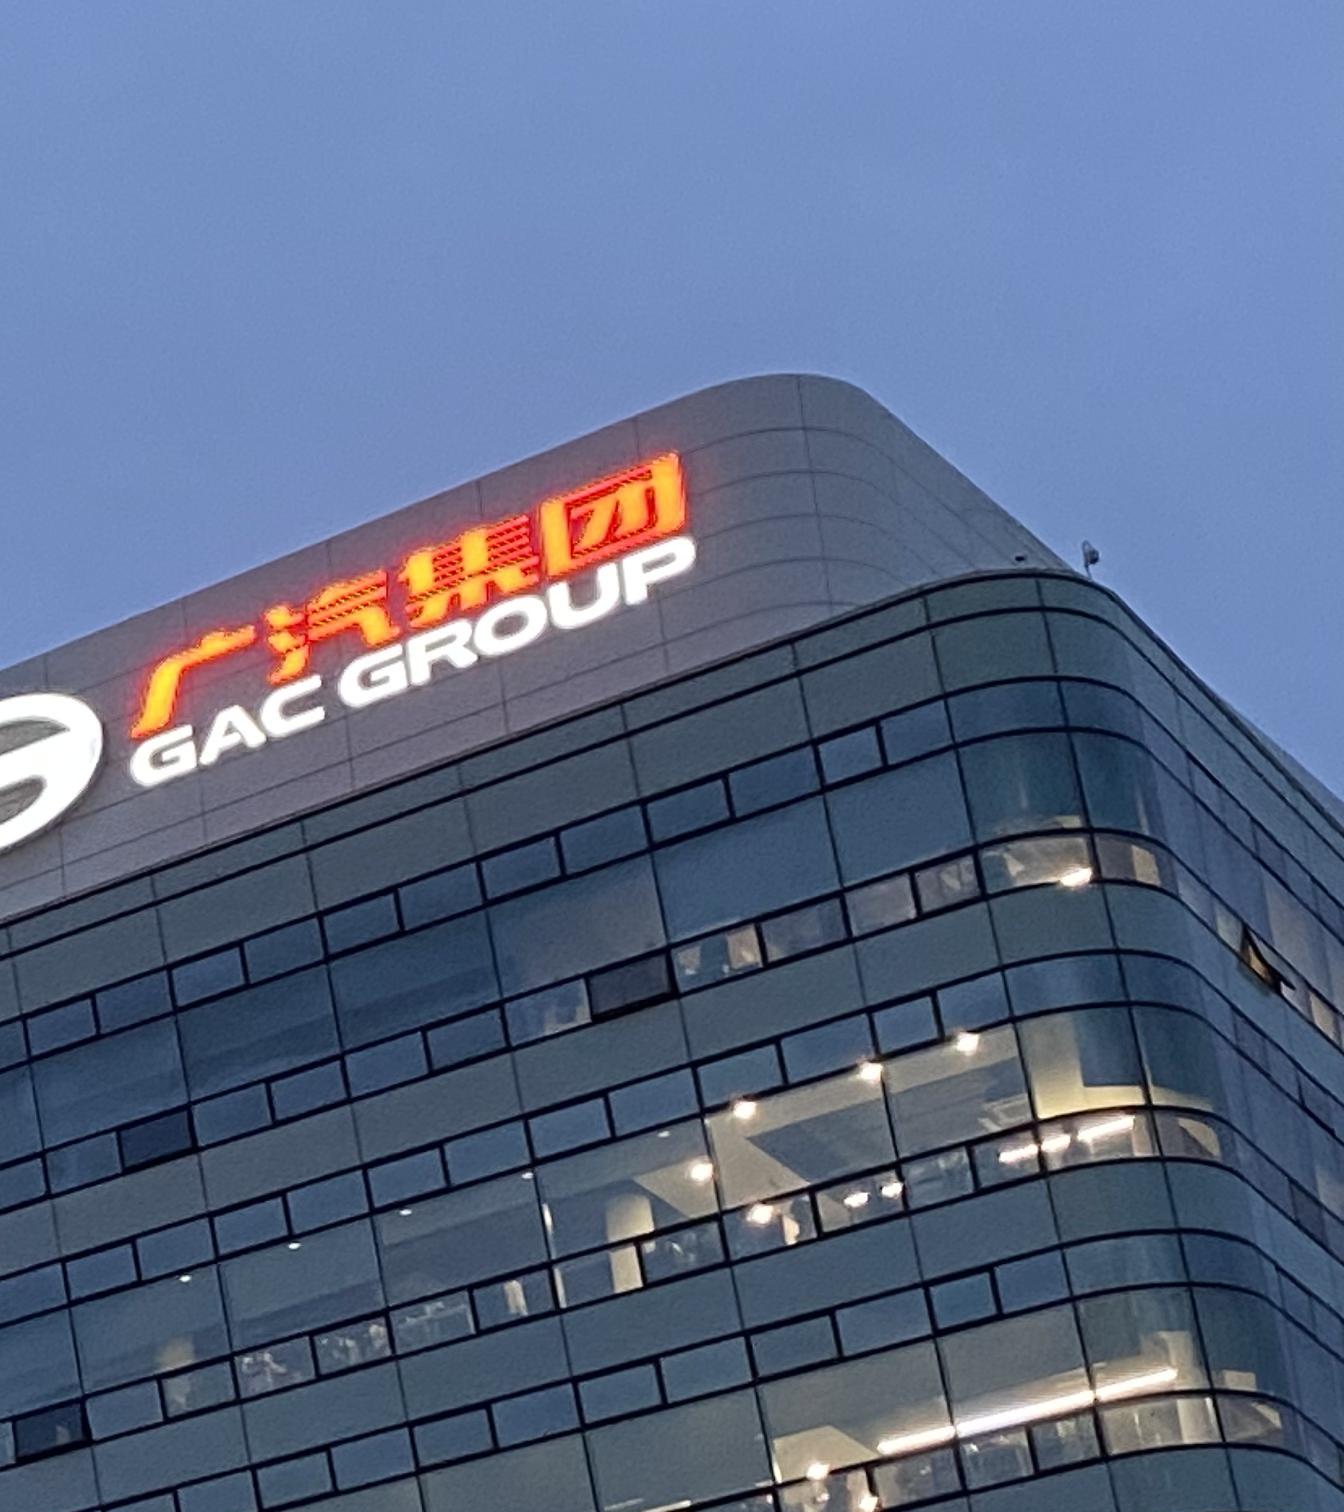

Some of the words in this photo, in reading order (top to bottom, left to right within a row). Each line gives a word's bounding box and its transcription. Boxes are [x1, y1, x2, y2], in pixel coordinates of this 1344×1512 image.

[129, 674, 326, 788] GAC
[337, 536, 697, 708] GROUP
[130, 451, 687, 740] 广汽集团
